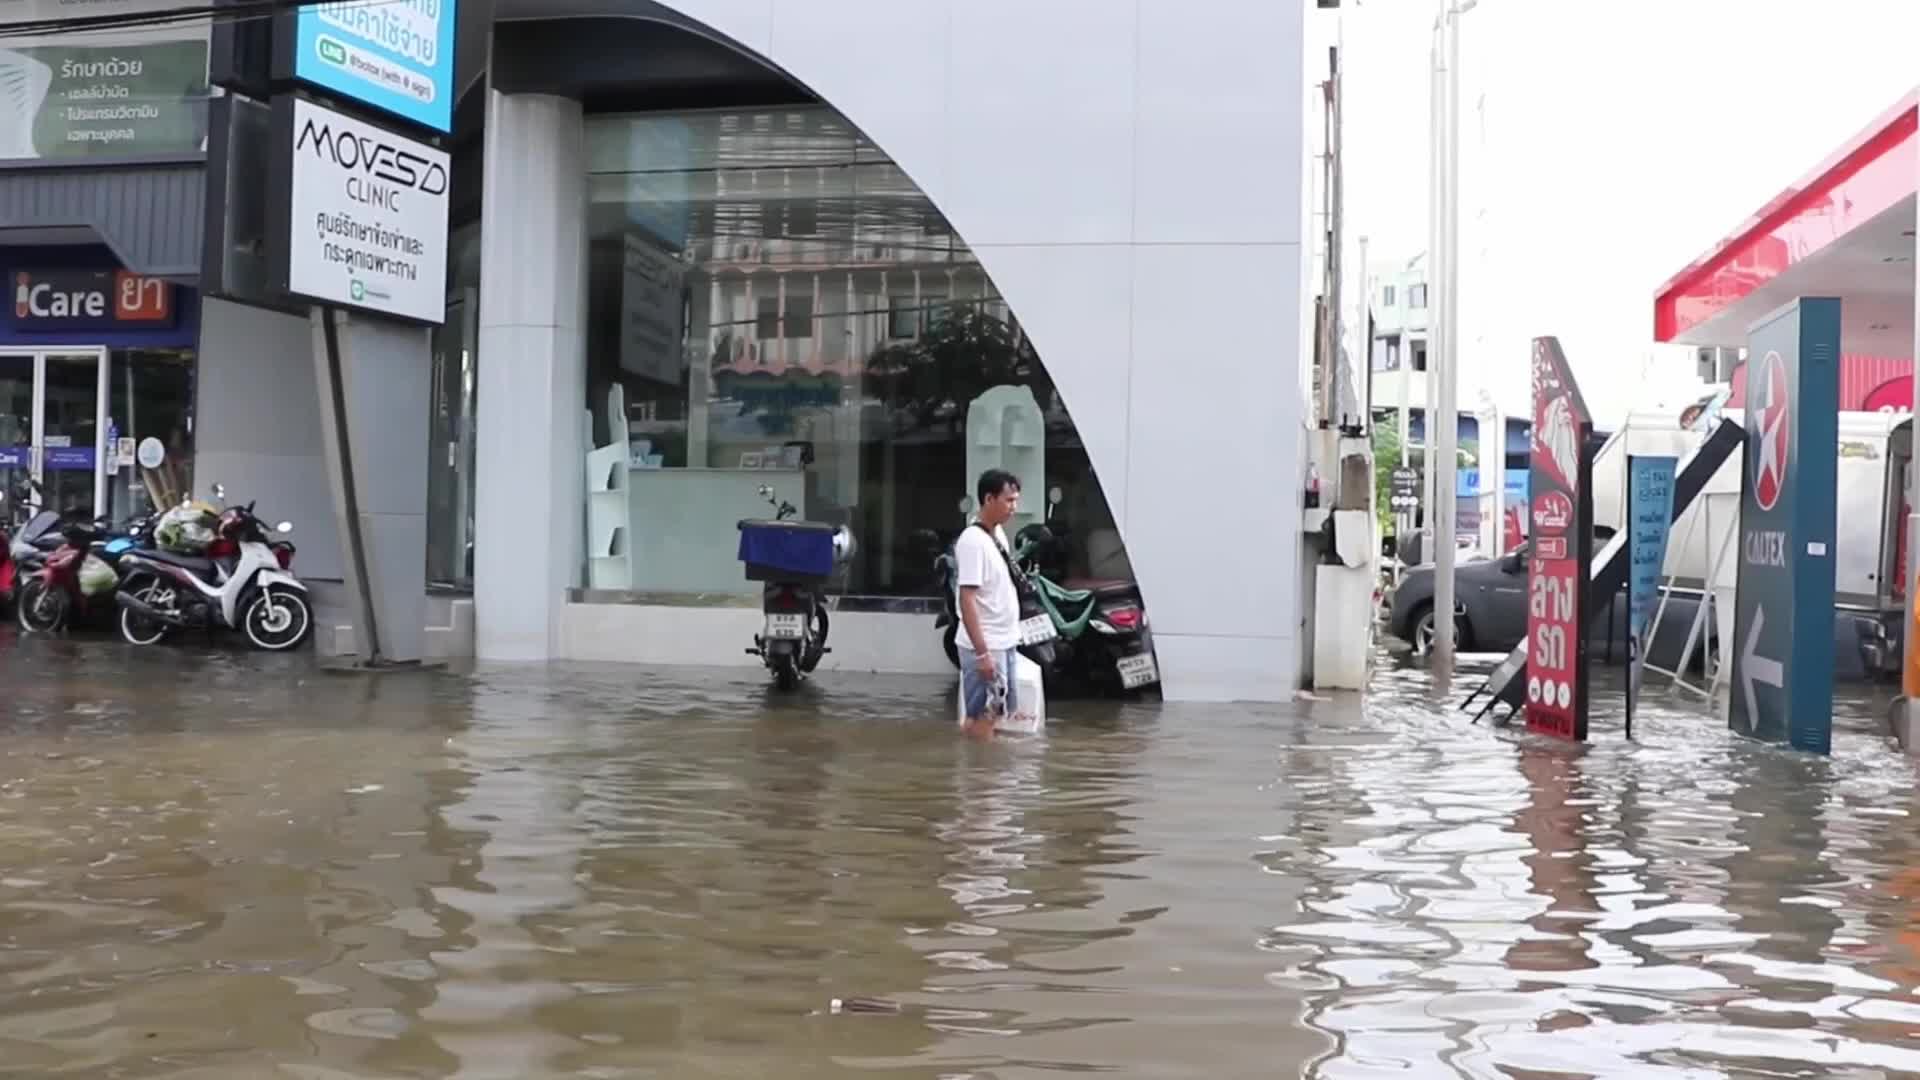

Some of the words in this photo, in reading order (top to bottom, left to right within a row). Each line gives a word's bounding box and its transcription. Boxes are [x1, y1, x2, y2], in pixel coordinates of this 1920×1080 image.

[61, 58, 142, 78] รักษาด้วย
[346, 177, 400, 213] CLINIC
[121, 277, 163, 312] ยา
[1745, 530, 1786, 568] CALTEX
[1530, 559, 1574, 623] ล้าง
[1535, 622, 1566, 671] รถ
